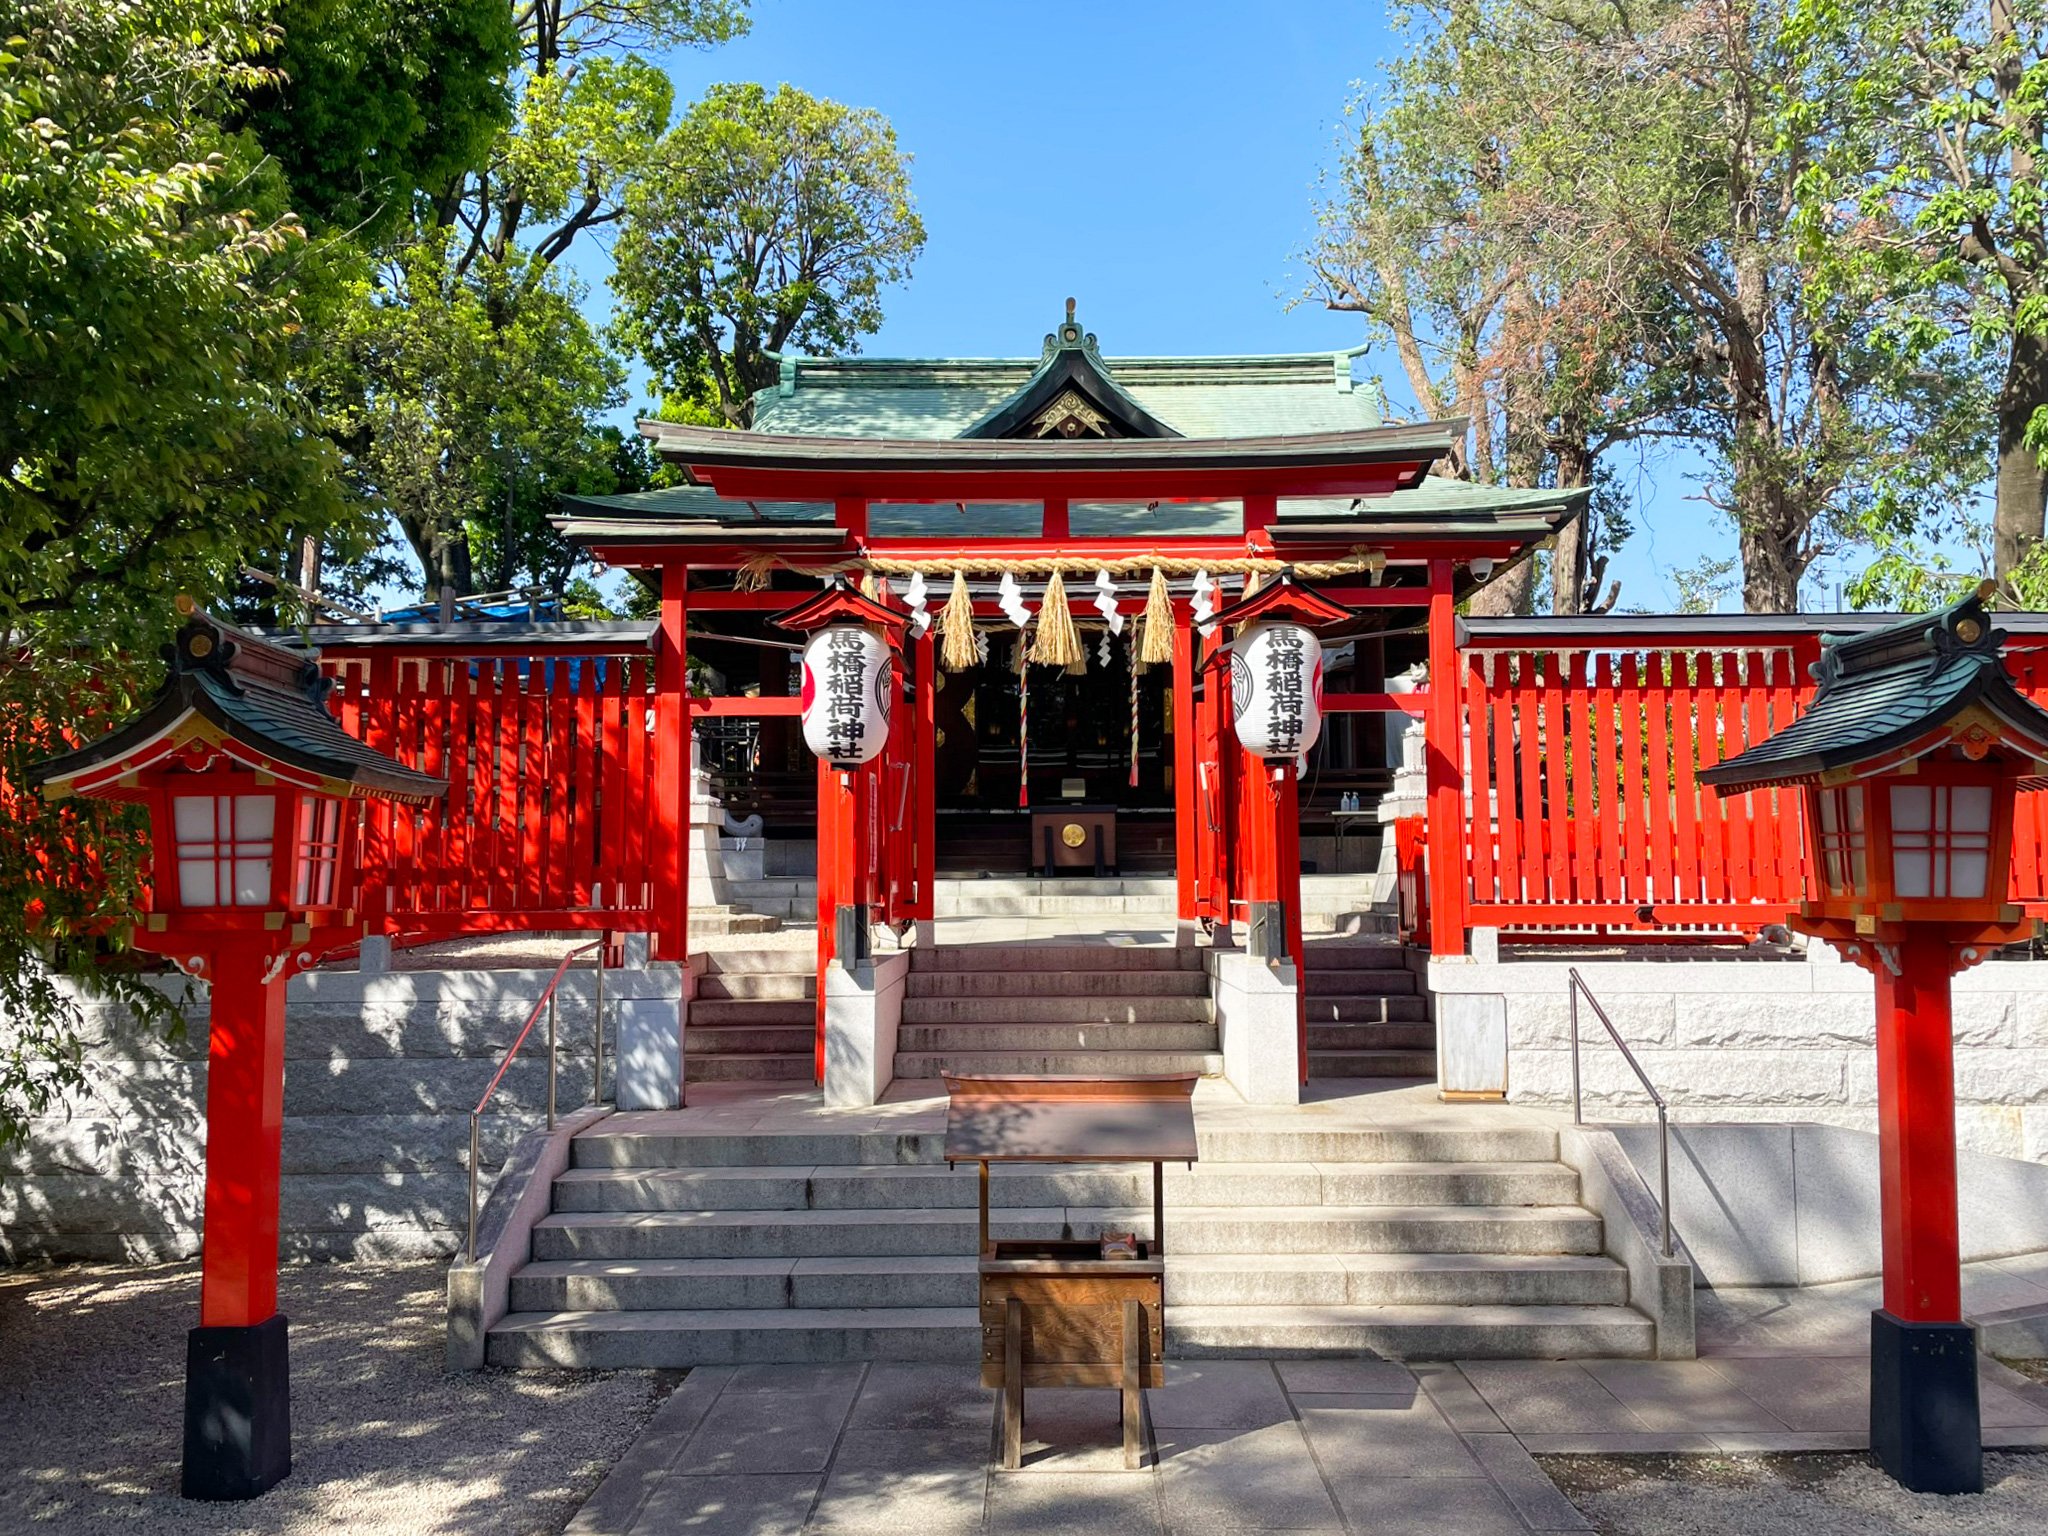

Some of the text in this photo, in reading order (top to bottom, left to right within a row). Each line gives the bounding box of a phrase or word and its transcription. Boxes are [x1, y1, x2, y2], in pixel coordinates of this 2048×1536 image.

[826, 630, 867, 759] 馬橋稲荷神社
[1265, 627, 1304, 754] 馬橋稲荷神社
